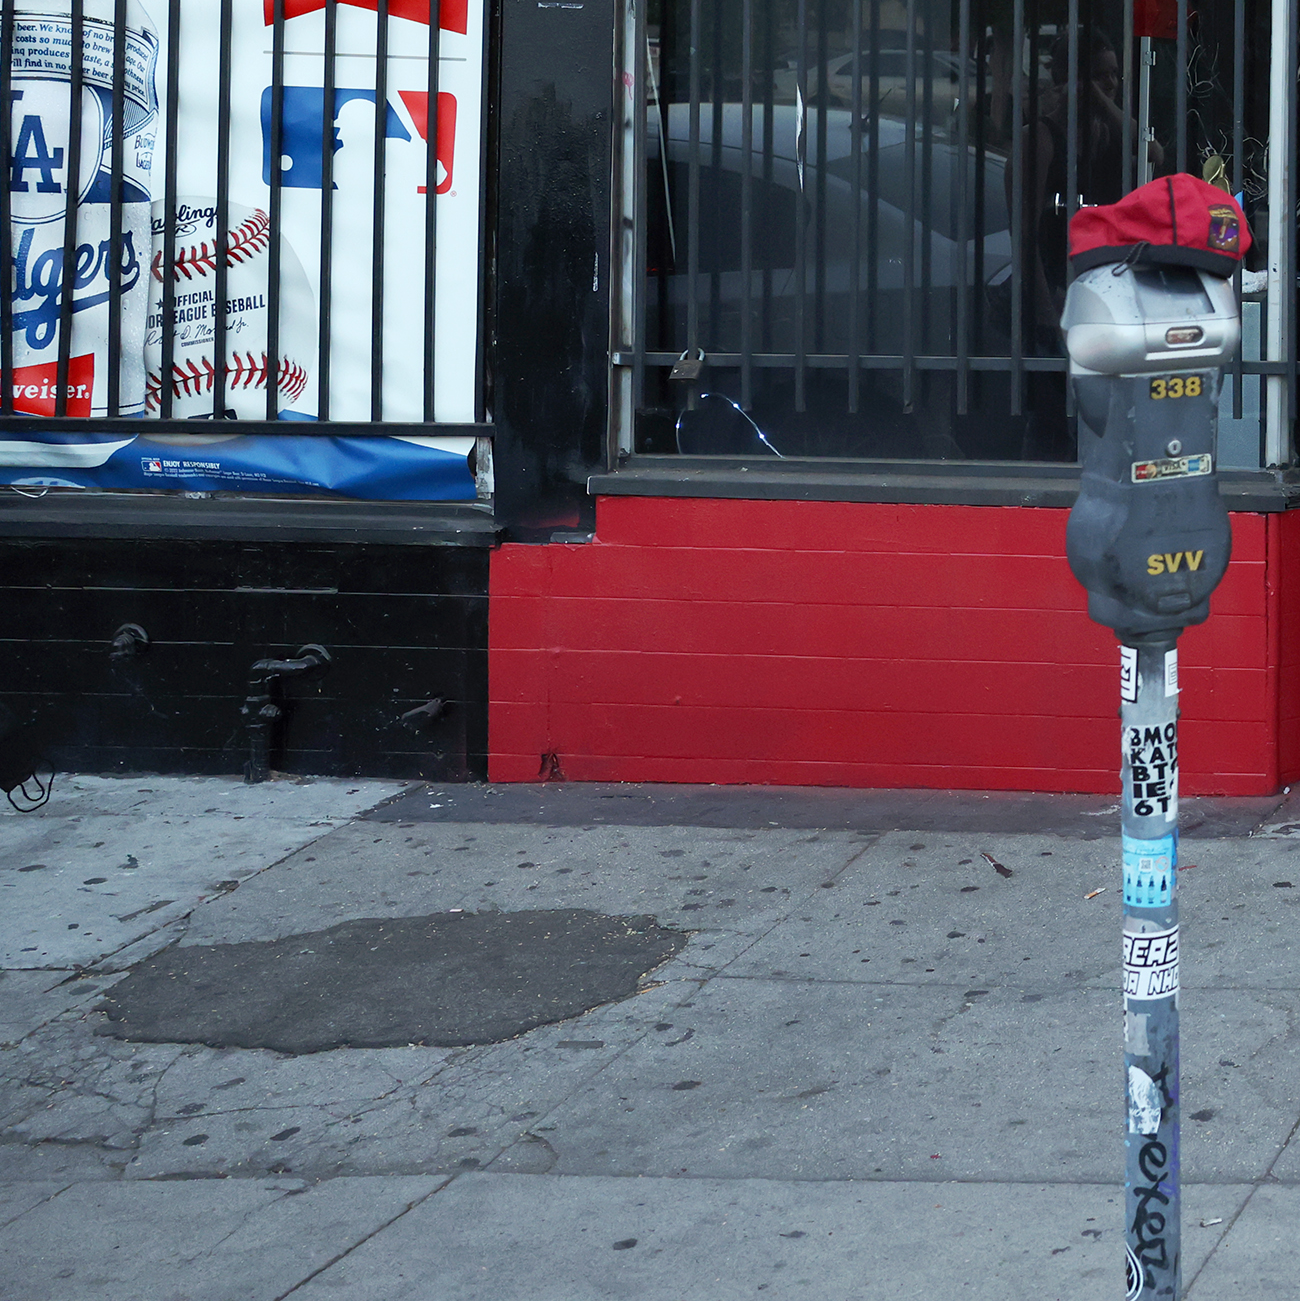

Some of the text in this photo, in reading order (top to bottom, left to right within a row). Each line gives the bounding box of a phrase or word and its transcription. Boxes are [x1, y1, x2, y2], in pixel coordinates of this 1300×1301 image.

[40, 24, 53, 33] We
[55, 25, 73, 34] kno
[53, 38, 73, 47] muc
[11, 59, 22, 67] ill
[151, 204, 218, 232] aling
[11, 228, 140, 350] dgers
[173, 305, 208, 325] EAGUE
[212, 294, 266, 316] BSEBALL
[11, 378, 88, 400] weiser
[1151, 376, 1201, 400] 338
[1147, 550, 1204, 576] SVV
